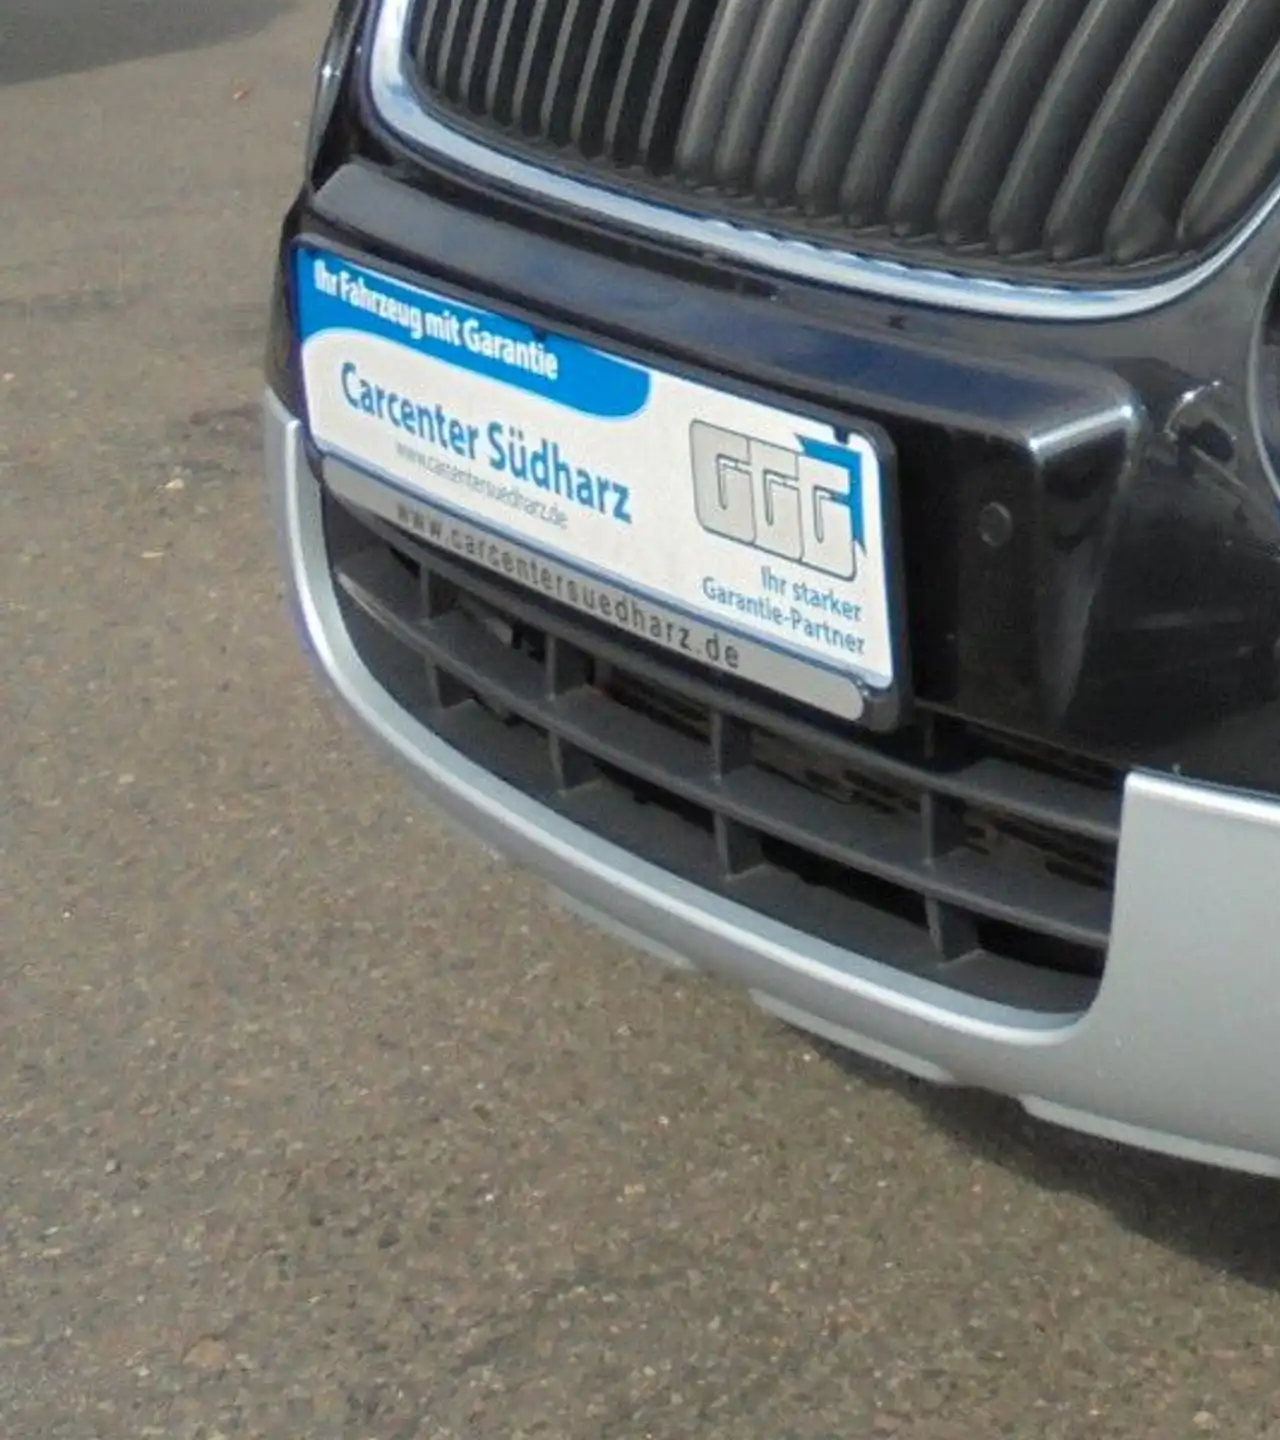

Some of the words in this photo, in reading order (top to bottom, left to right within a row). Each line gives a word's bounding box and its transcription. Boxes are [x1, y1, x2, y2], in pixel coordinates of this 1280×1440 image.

[313, 258, 338, 297] Ihr
[339, 270, 423, 340] Fahrzeug
[425, 310, 461, 347] mit
[462, 317, 559, 381] Garantie
[341, 361, 479, 460] Carcenter
[486, 421, 633, 525] Südharz
[702, 575, 866, 655] Garantie-Partner
[761, 565, 788, 596] Ihr
[792, 580, 862, 623] starker
